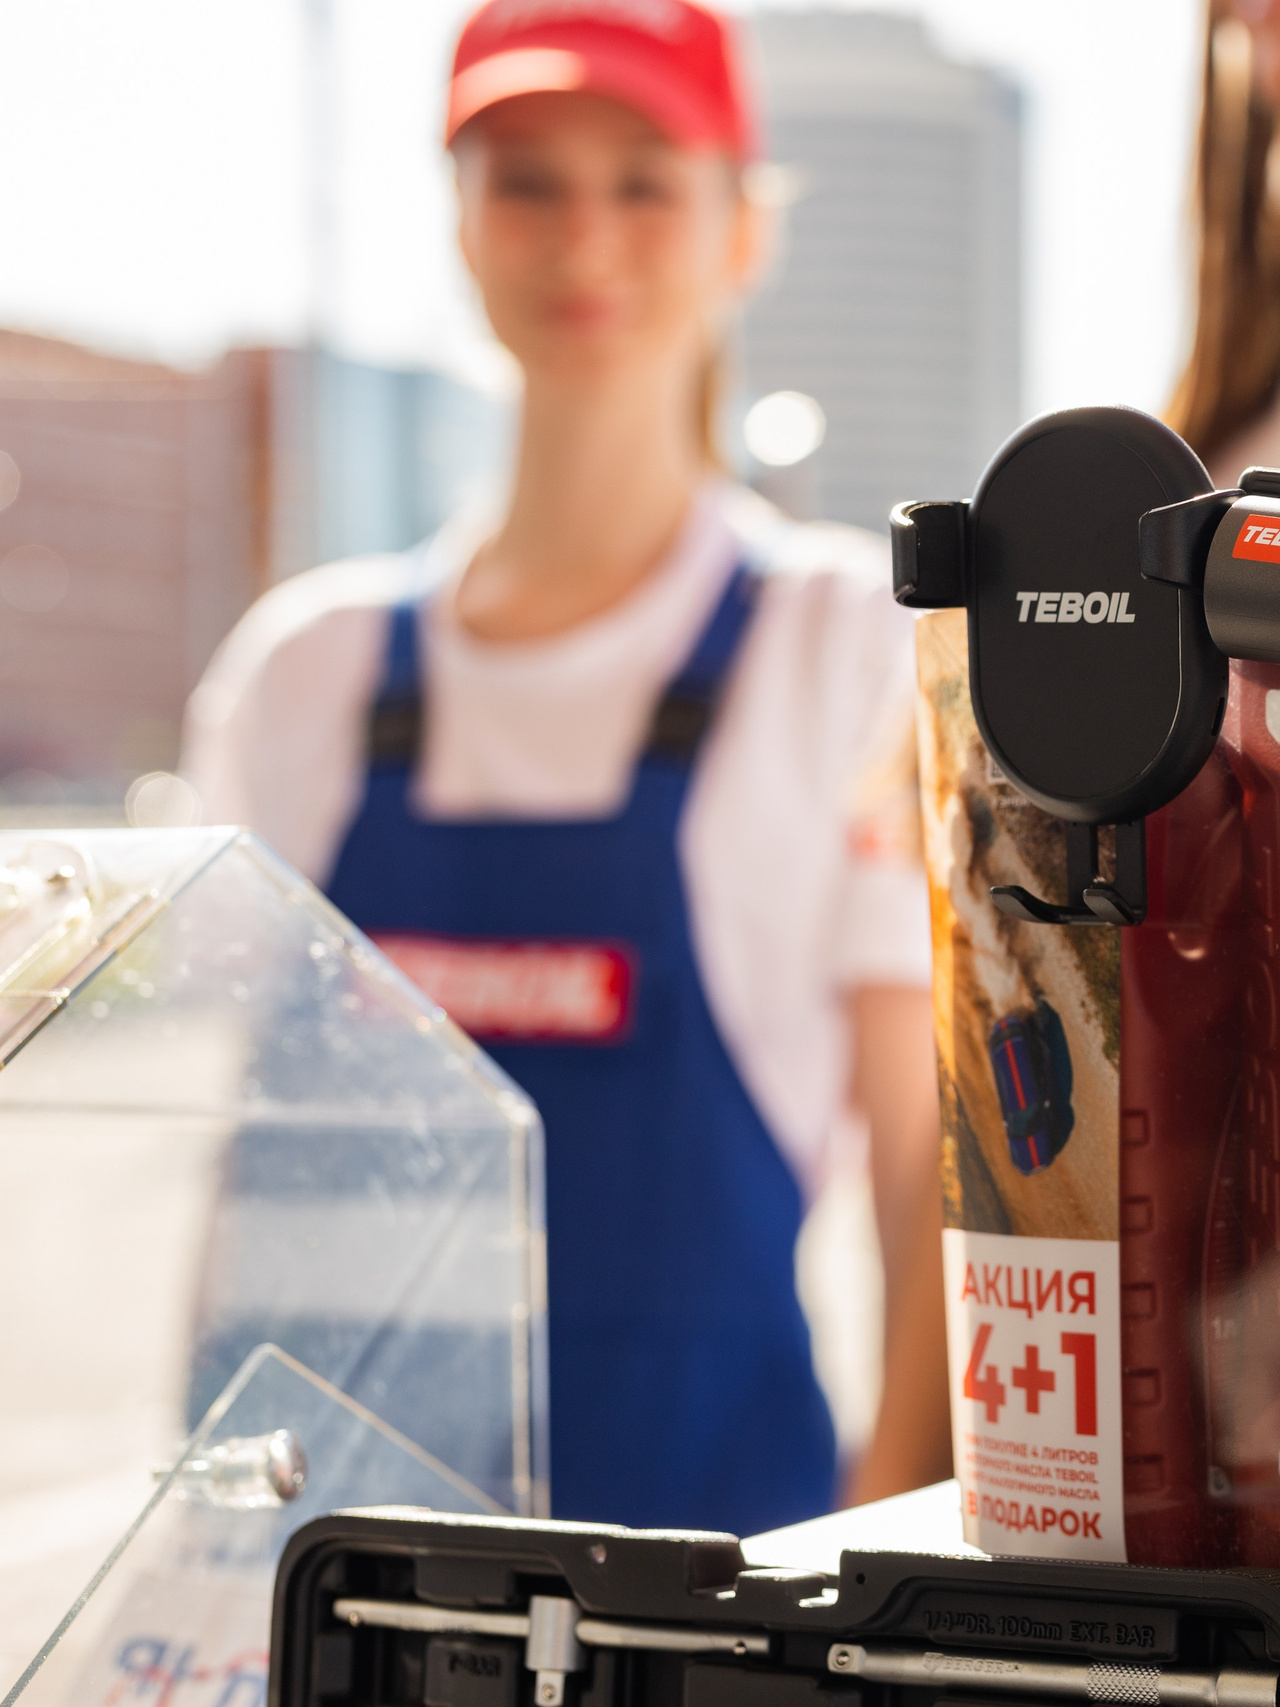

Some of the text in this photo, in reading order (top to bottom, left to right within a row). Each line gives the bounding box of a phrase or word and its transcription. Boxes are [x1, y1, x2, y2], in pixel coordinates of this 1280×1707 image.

[1015, 591, 1136, 624] TEBOIL
[962, 1261, 1096, 1319] АКЦИЯ
[963, 1322, 1098, 1437] 4+1
[1041, 1446, 1099, 1466] ЛИТРОВ
[1058, 1486, 1101, 1501] МАСЛА
[980, 1495, 1103, 1540] ПОДАРОК
[998, 1615, 1063, 1641] 100mm
[1069, 1620, 1111, 1643] EXT.
[1115, 1624, 1156, 1647] BAR
